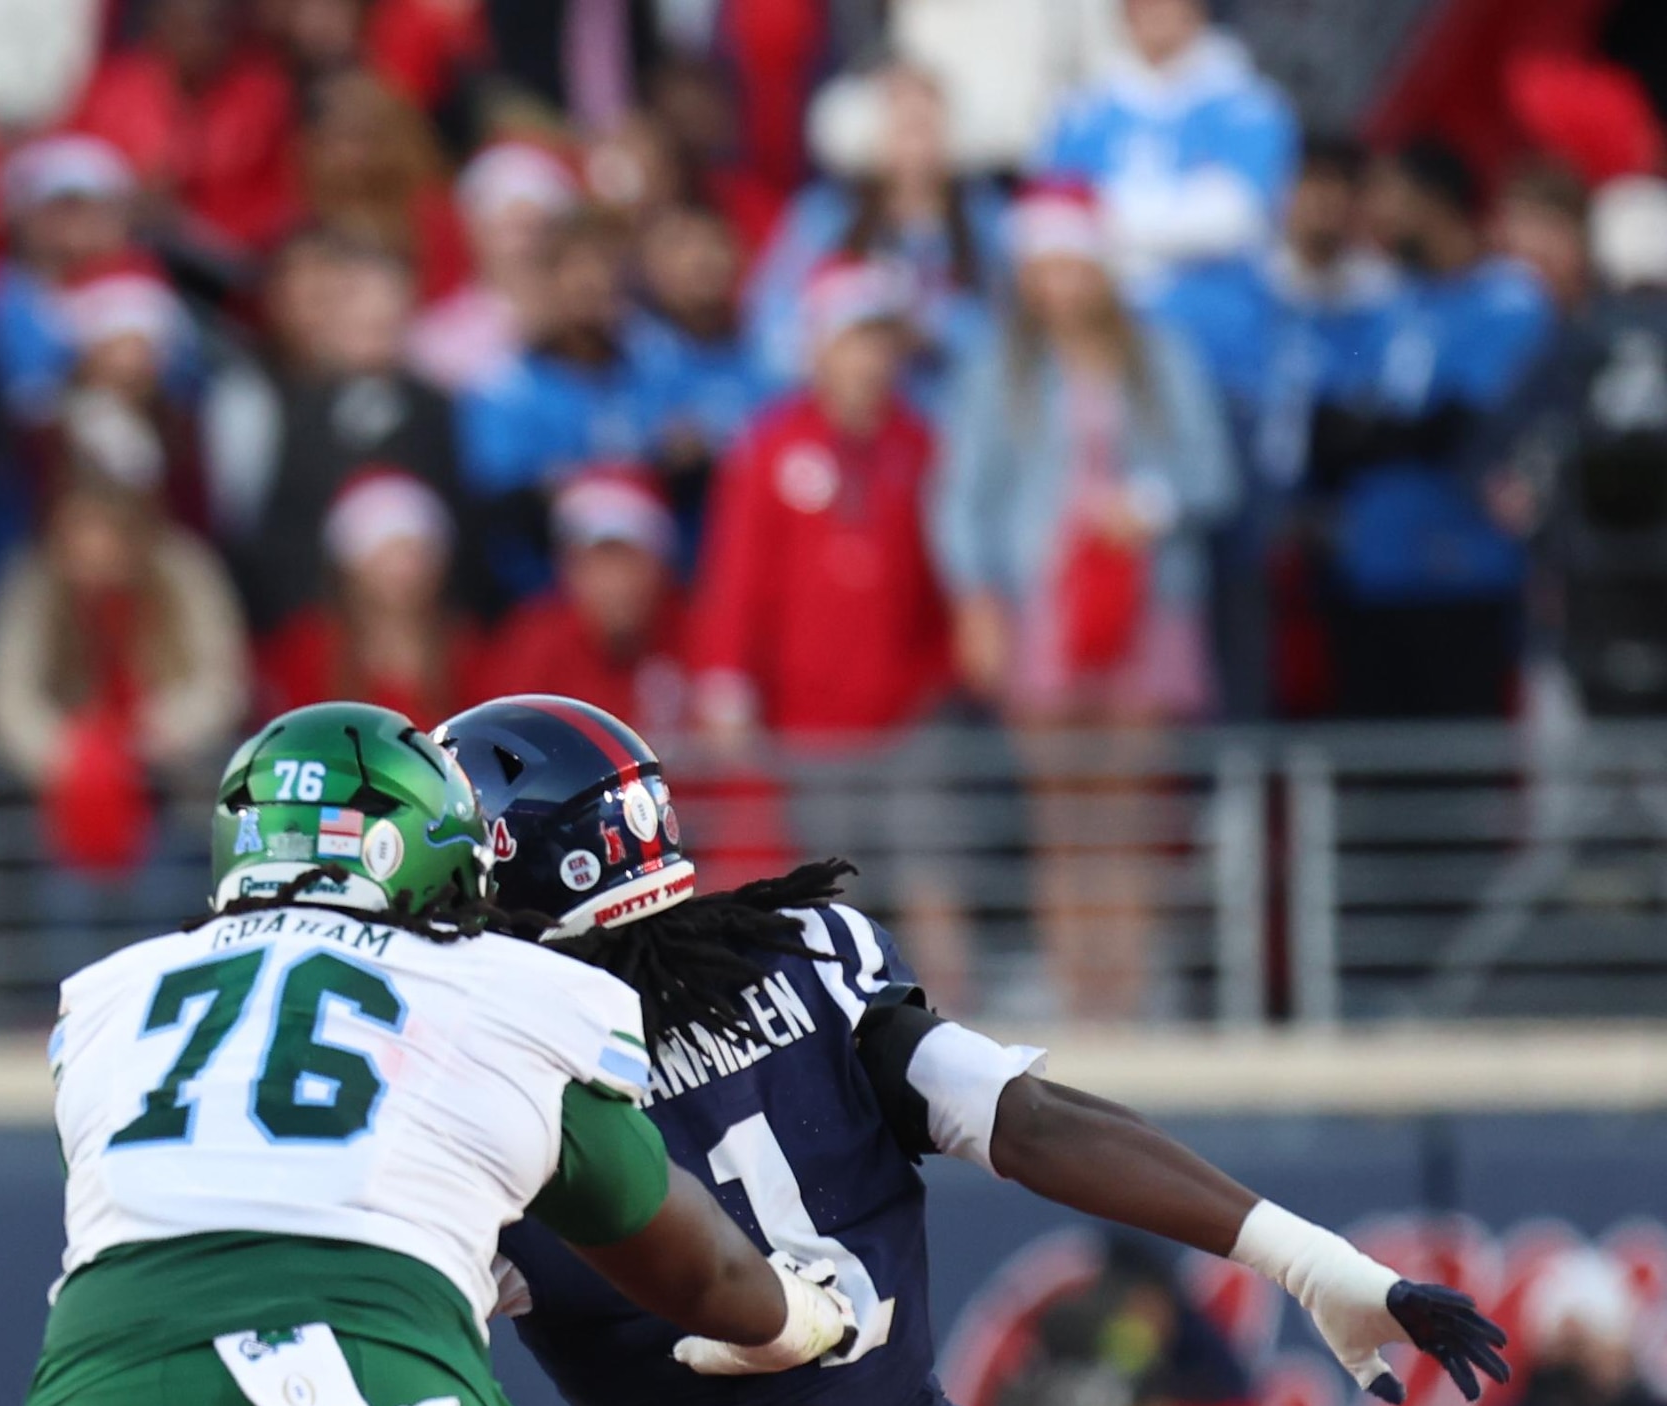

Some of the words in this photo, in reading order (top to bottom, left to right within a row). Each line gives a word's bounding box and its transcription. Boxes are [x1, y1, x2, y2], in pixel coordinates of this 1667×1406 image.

[274, 760, 326, 802] 76
[101, 942, 409, 1155] 76
[707, 1111, 894, 1368] 1
